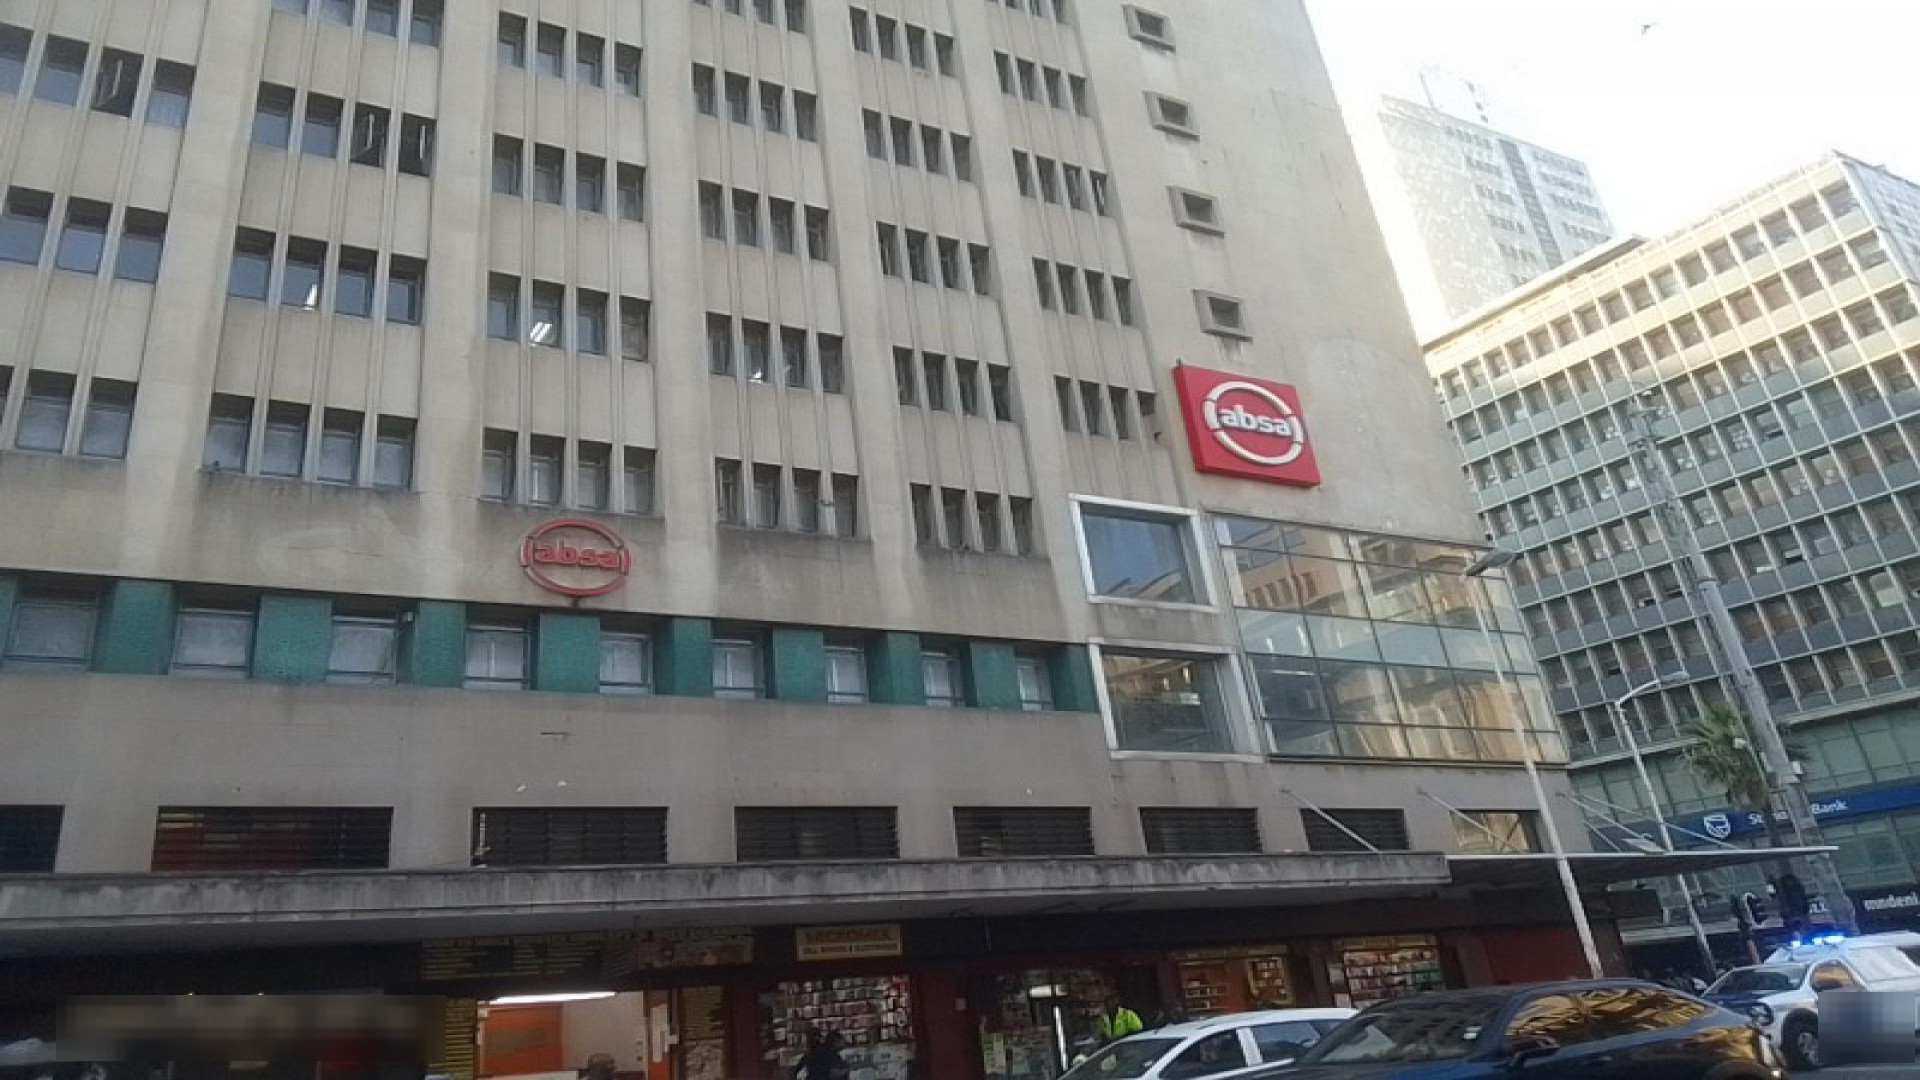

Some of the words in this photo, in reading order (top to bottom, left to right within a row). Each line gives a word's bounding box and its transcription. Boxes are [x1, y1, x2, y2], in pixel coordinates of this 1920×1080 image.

[1219, 404, 1292, 436] absa
[533, 539, 621, 570] absa
[1811, 799, 1849, 814] Bank
